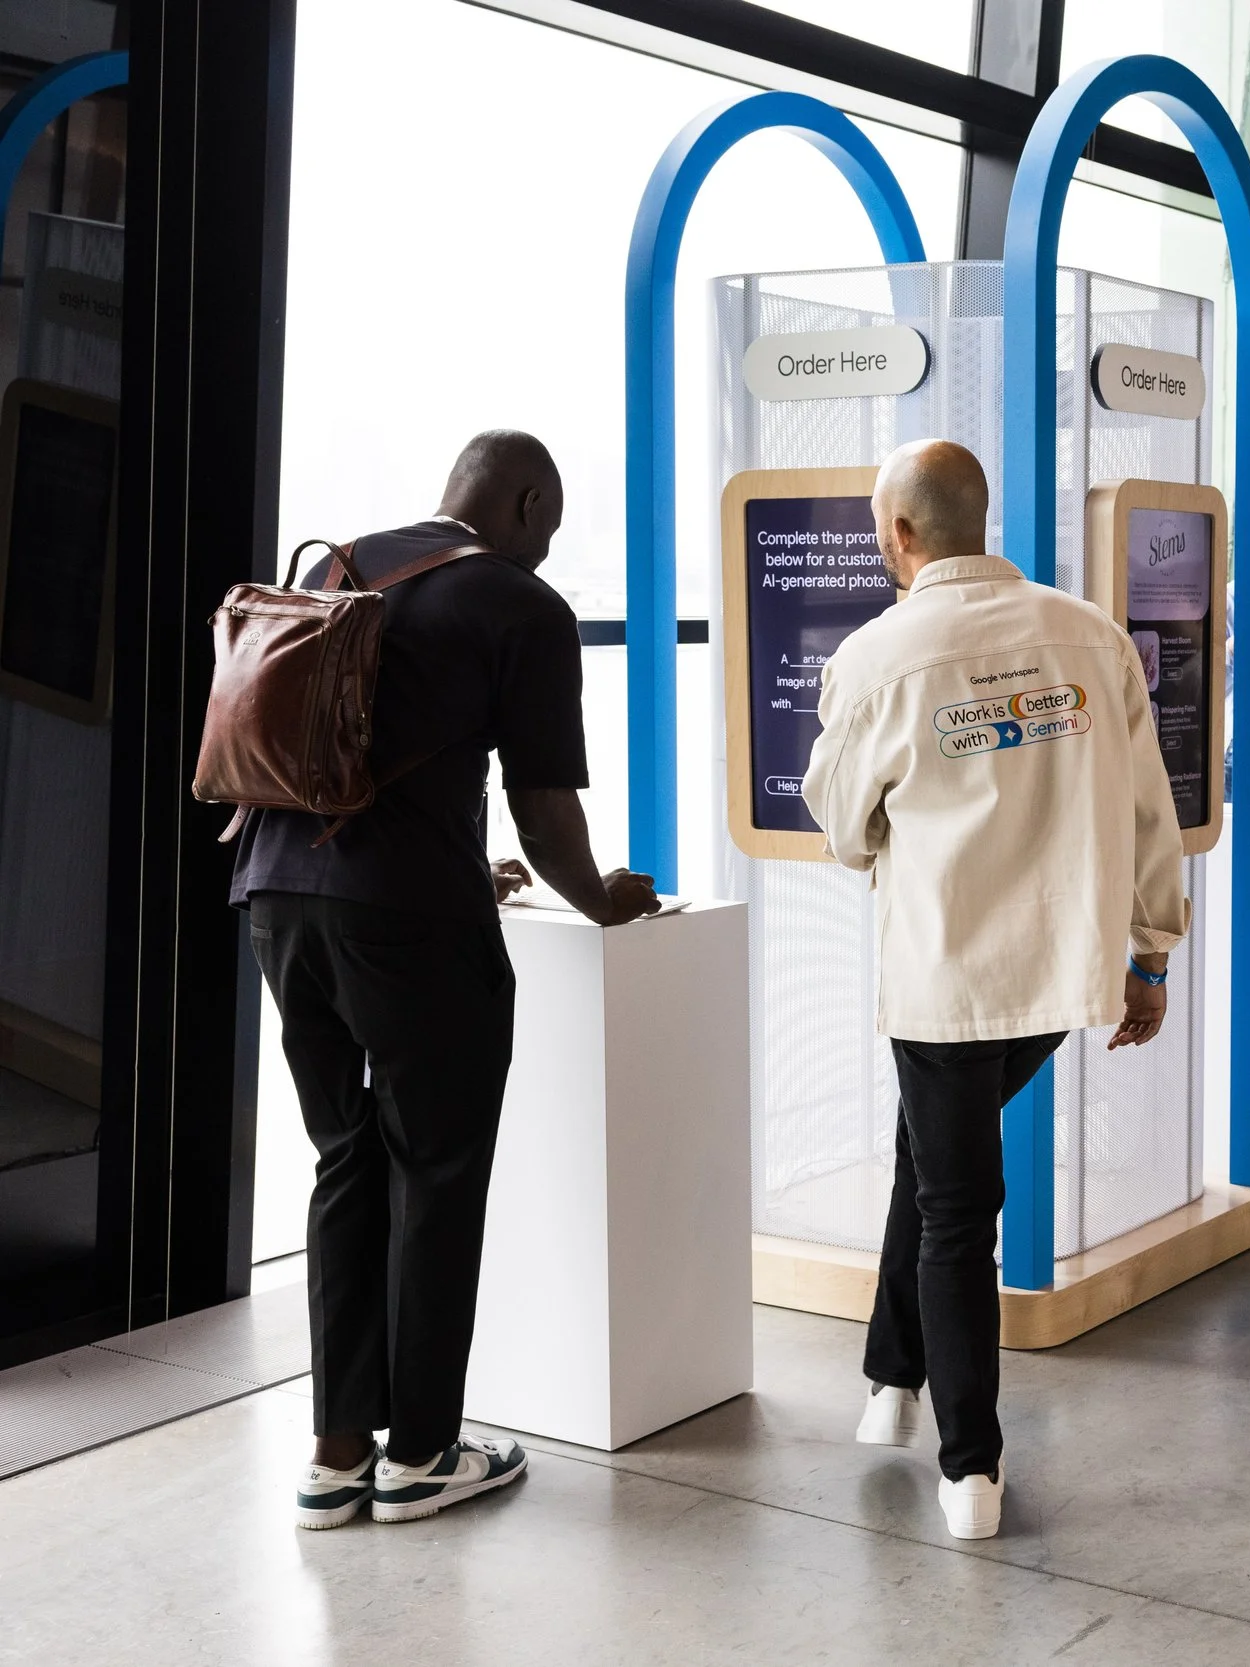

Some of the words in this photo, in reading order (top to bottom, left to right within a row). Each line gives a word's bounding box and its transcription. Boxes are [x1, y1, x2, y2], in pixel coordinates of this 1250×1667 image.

[778, 354, 835, 377] Order
[841, 351, 887, 372] Here
[1121, 365, 1156, 391] Order
[1159, 372, 1186, 396] Here
[757, 530, 819, 548] Complete
[821, 530, 843, 545] the
[845, 532, 877, 548] prom
[1148, 532, 1186, 567] Stems
[765, 552, 803, 567] below
[806, 551, 824, 566] for
[827, 555, 835, 566] a
[838, 553, 886, 566] custom
[762, 573, 845, 591] AI-generated
[848, 573, 890, 591] photo.
[780, 653, 788, 664] A
[803, 655, 815, 664] art
[776, 676, 805, 690] image
[806, 676, 817, 687] of
[970, 673, 998, 685] Google
[998, 666, 1040, 682] Workspace
[771, 698, 791, 709] with
[947, 704, 991, 726] Work
[992, 703, 1006, 718] is
[1025, 692, 1071, 712] better
[952, 731, 989, 751] with
[1026, 714, 1078, 737] Gemini
[777, 780, 799, 794] Help
